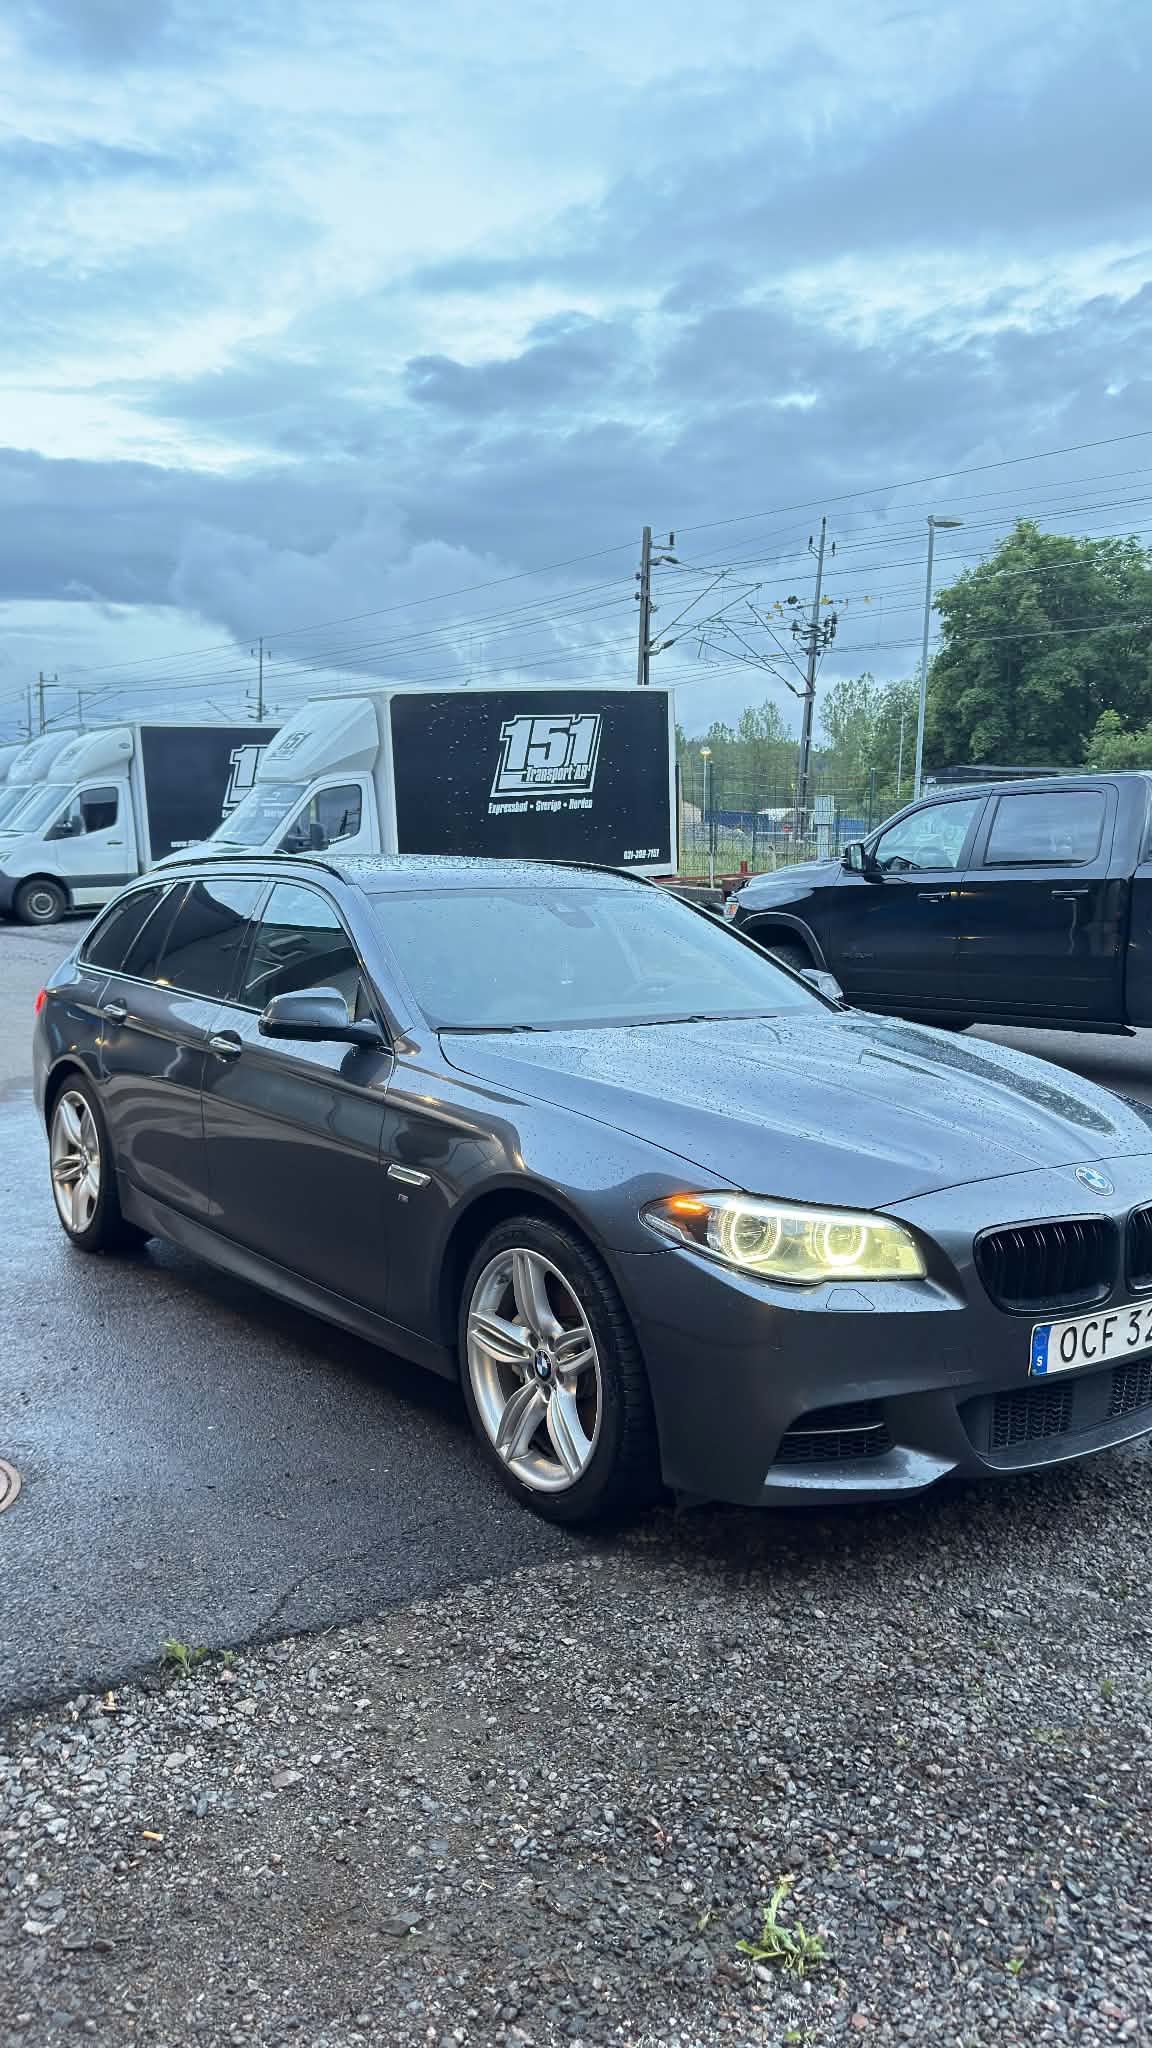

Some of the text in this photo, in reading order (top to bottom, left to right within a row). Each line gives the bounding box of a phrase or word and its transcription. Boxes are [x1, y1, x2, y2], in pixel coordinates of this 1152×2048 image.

[503, 718, 596, 769] 151
[526, 764, 589, 783] Transport AB
[536, 800, 561, 812] Sverige
[569, 798, 592, 809] Norden
[1060, 1316, 1118, 1363] OCF
[1036, 1356, 1043, 1366] S
